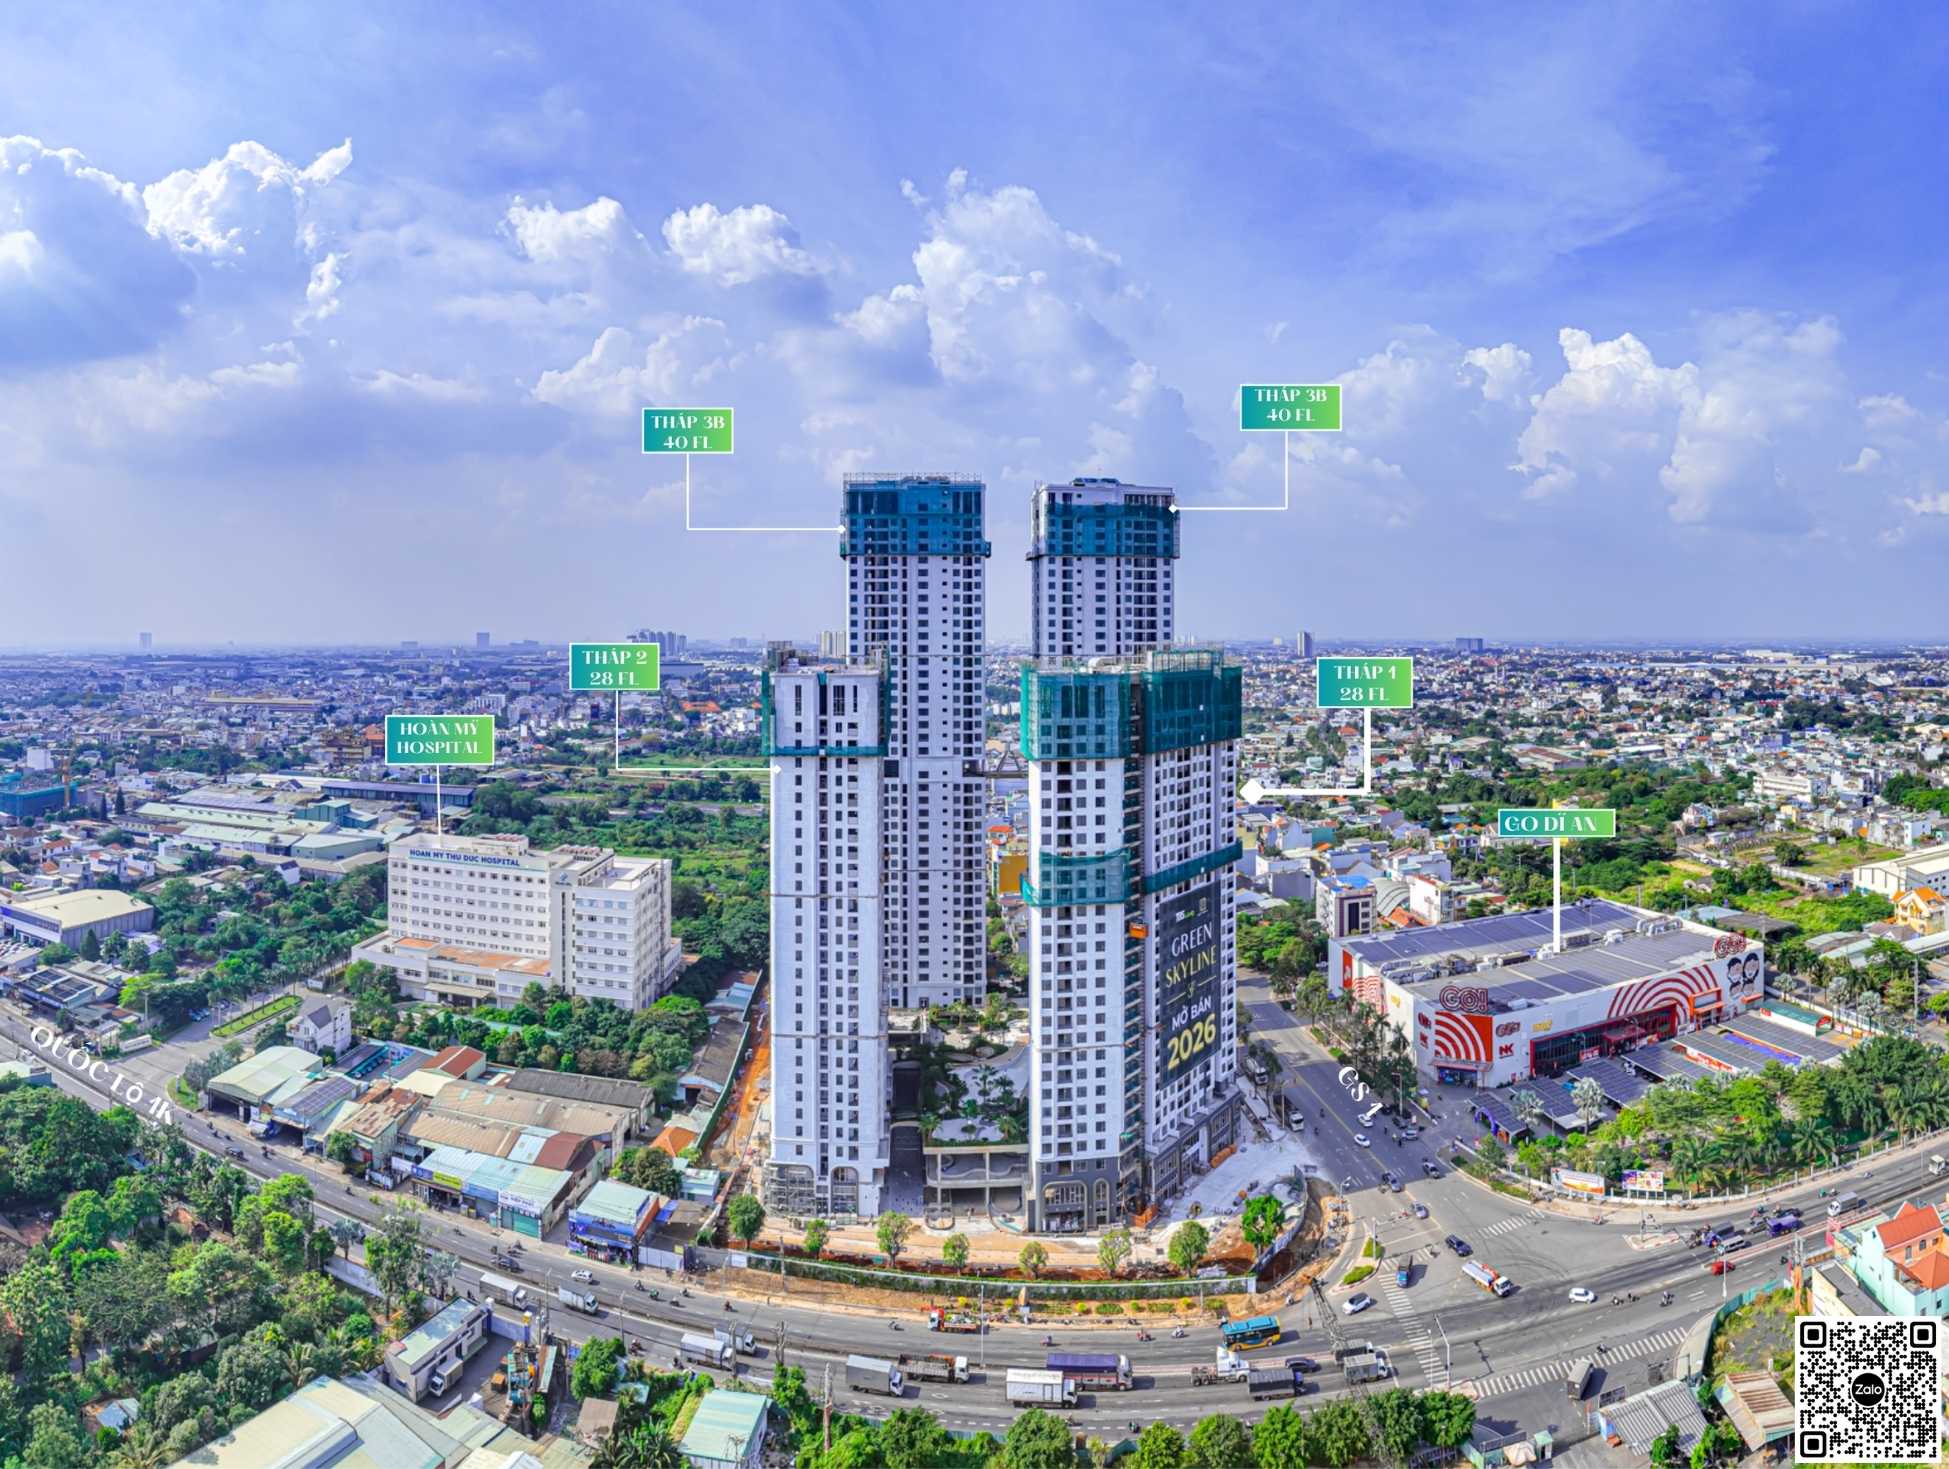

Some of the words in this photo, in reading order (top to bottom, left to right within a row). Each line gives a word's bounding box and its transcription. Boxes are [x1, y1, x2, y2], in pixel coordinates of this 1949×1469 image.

[409, 848, 431, 858] HOAN
[446, 852, 462, 861] THU
[463, 855, 480, 863] DUC
[481, 856, 520, 866] HOSPITAL
[1171, 921, 1213, 958] GREEN
[1166, 944, 1217, 989] SKYLINE
[1190, 994, 1212, 1020] BÁN
[1439, 985, 1488, 1013] GO!
[1167, 1012, 1217, 1070] 2026
